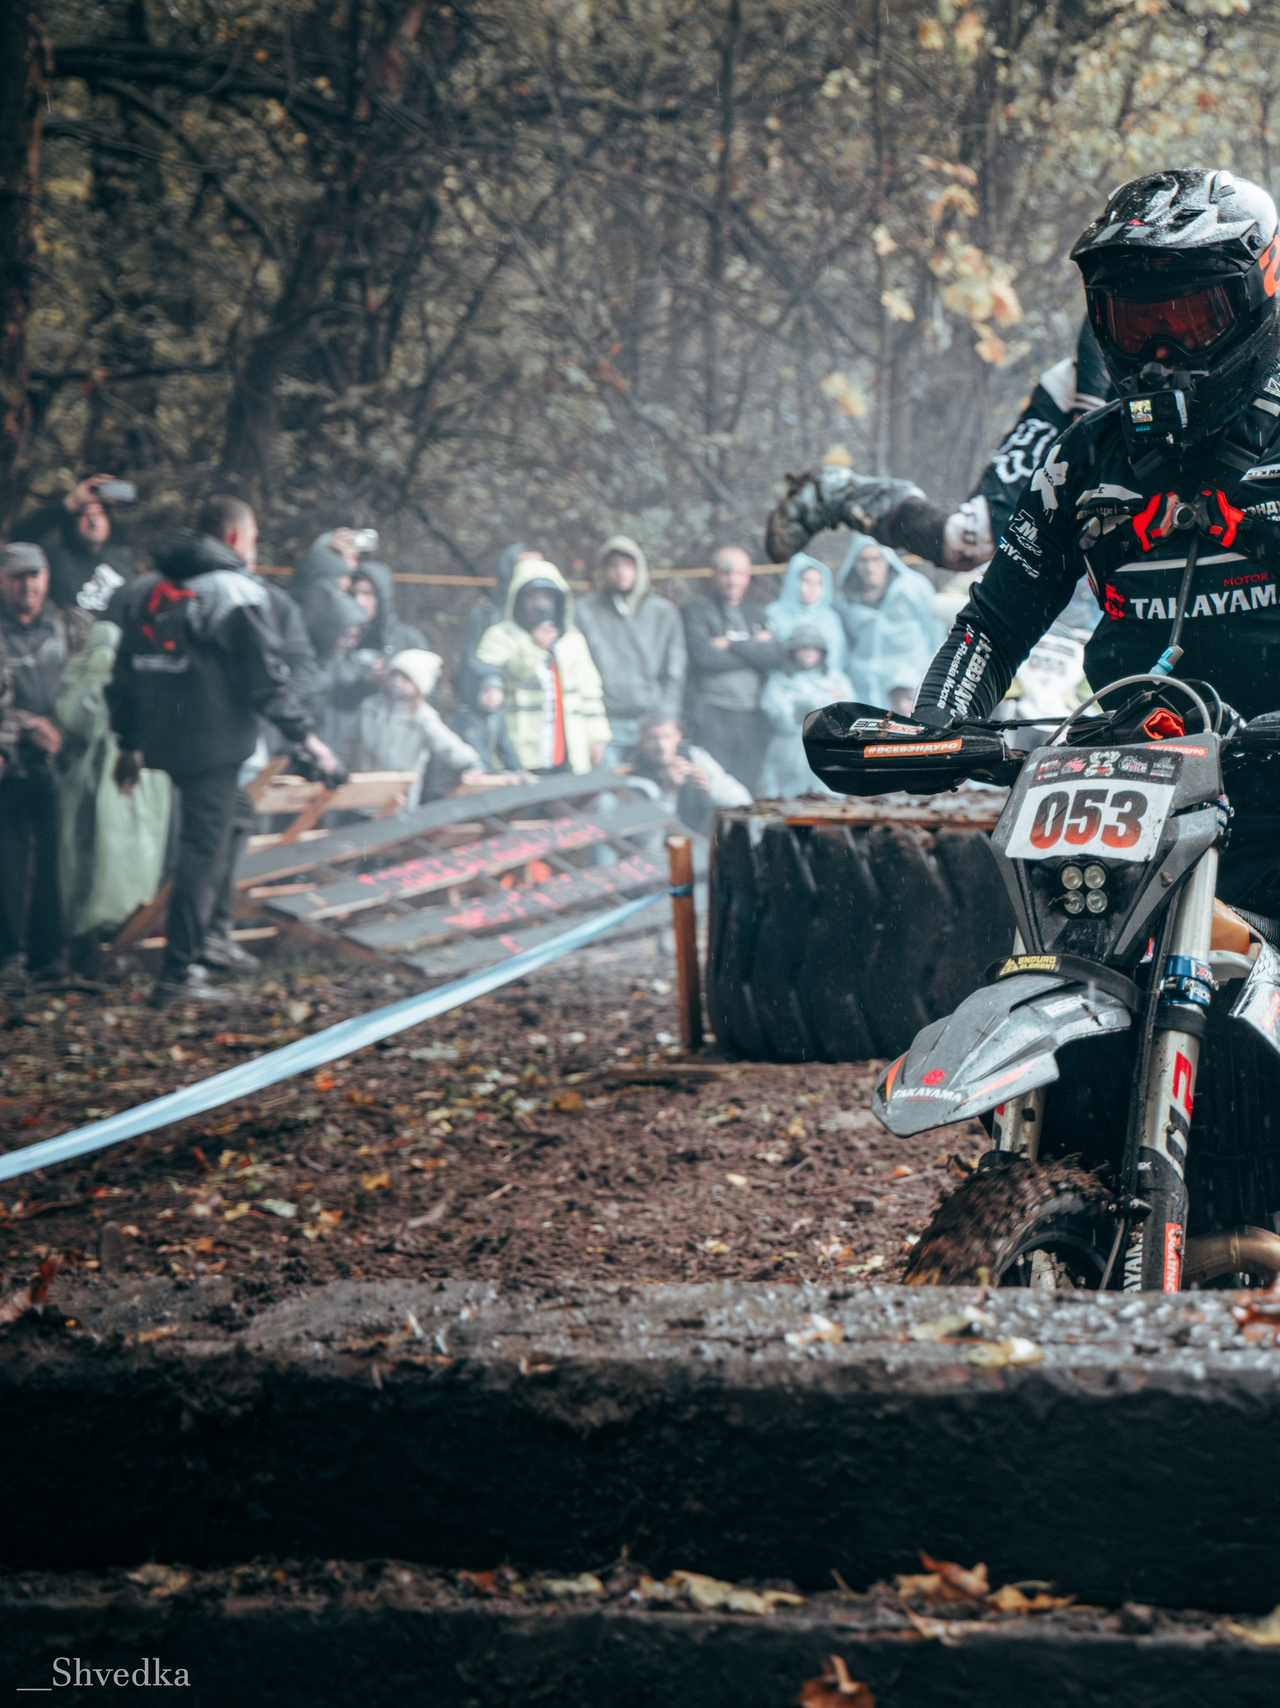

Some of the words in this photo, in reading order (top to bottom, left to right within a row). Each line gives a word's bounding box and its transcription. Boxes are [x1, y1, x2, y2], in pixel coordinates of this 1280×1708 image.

[1223, 573, 1268, 587] MOTOR
[868, 742, 958, 754] #ВСЕВЭНДУРО
[1029, 788, 1148, 849] 053
[1018, 955, 1057, 964] ENDURO
[892, 1087, 962, 1102] TAKAYAMA
